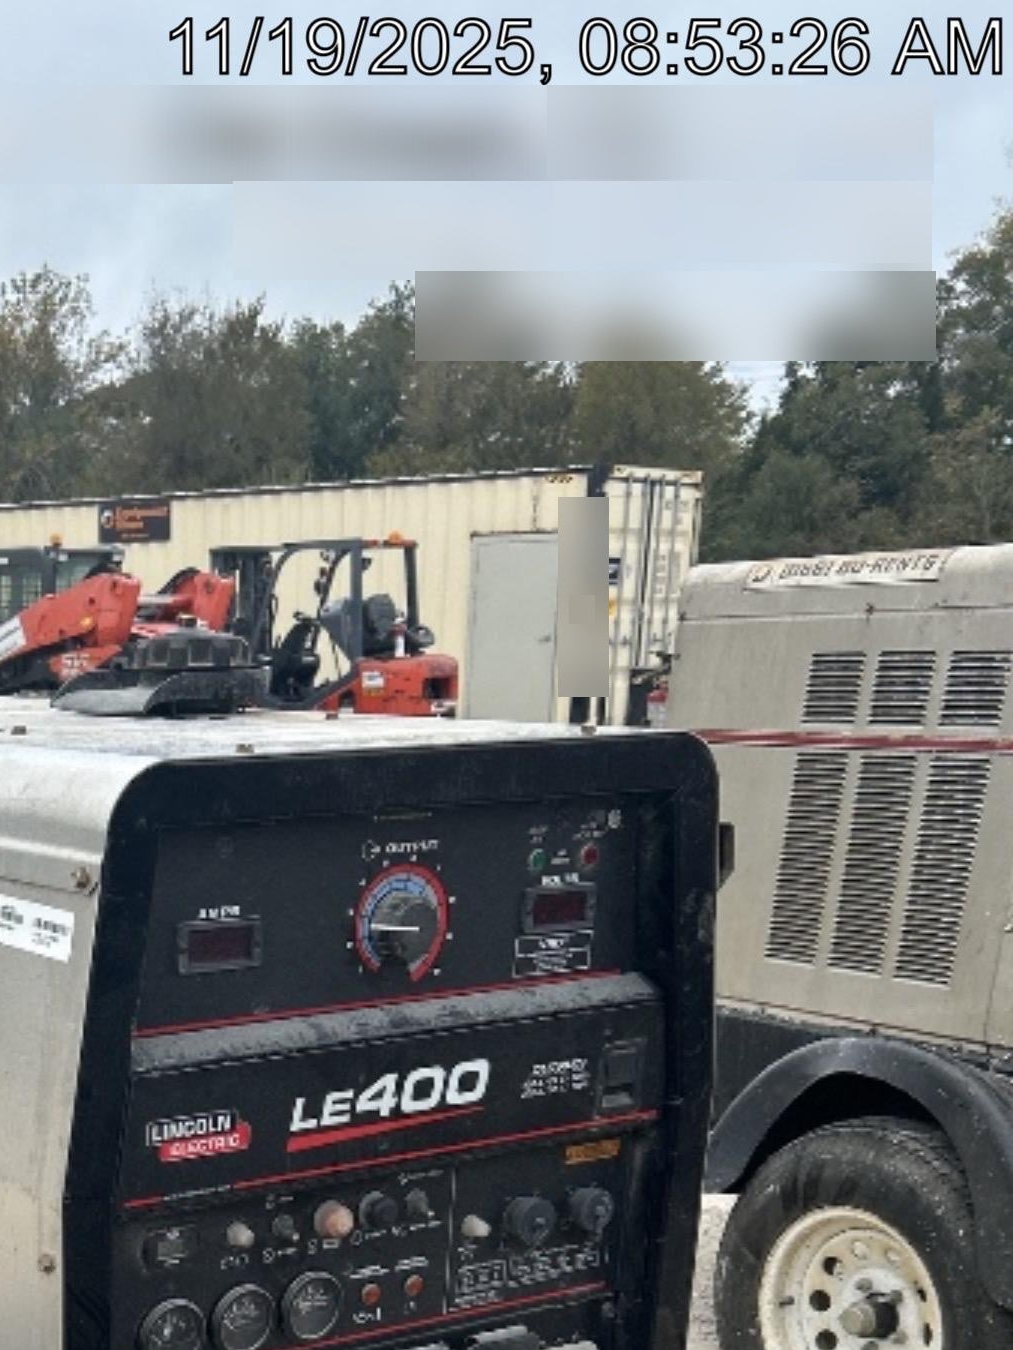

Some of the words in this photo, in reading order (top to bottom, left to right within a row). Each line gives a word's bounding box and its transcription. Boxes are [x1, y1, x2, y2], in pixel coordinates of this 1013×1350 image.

[289, 1057, 492, 1133] LE400
[151, 1114, 232, 1142] LINCOLN
[168, 1133, 241, 1156] ELECTRIC
